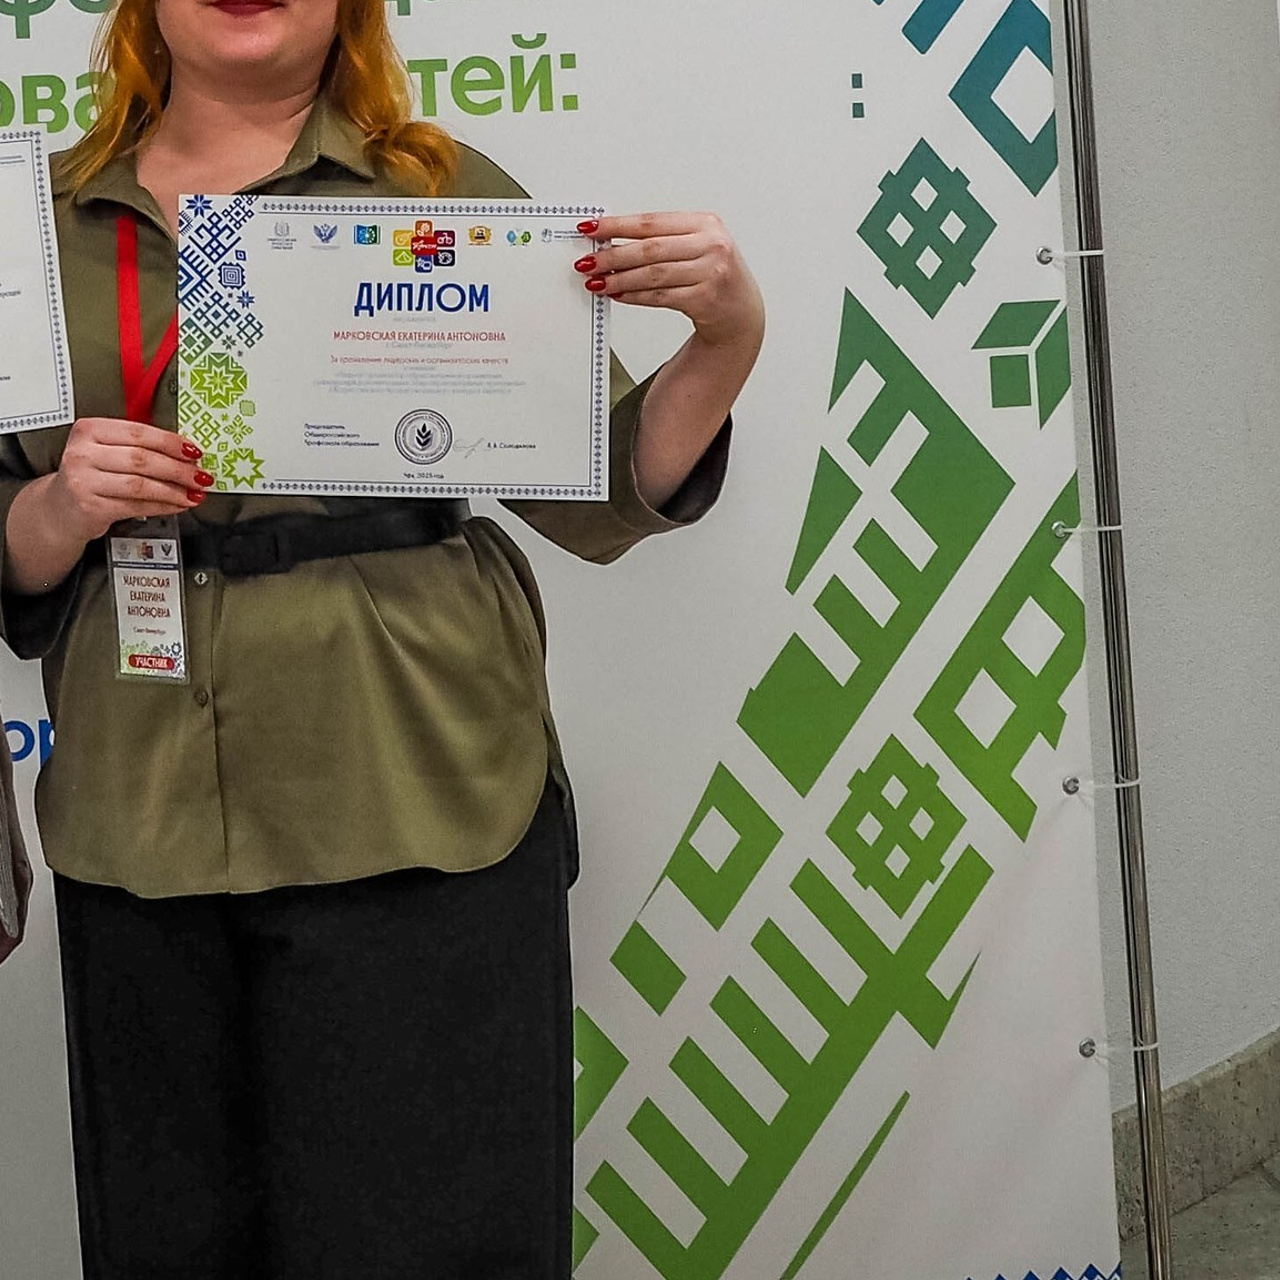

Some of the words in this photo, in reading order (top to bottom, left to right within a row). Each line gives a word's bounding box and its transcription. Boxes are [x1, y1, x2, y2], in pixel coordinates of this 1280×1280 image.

[406, 32, 579, 118] тей:
[354, 282, 489, 317] ДИПЛОМ
[333, 331, 396, 341] МАРКОВСКАЯ
[397, 331, 446, 342] ЕКАТЕРИНА
[447, 331, 506, 342] АНТОНОВНА
[123, 575, 170, 588] МАРКОВСКАЯ
[130, 590, 166, 602] ЕКАТЕРИНА
[127, 605, 171, 618] АНТОНОВНА
[134, 656, 168, 668] УЧАСТНИК
